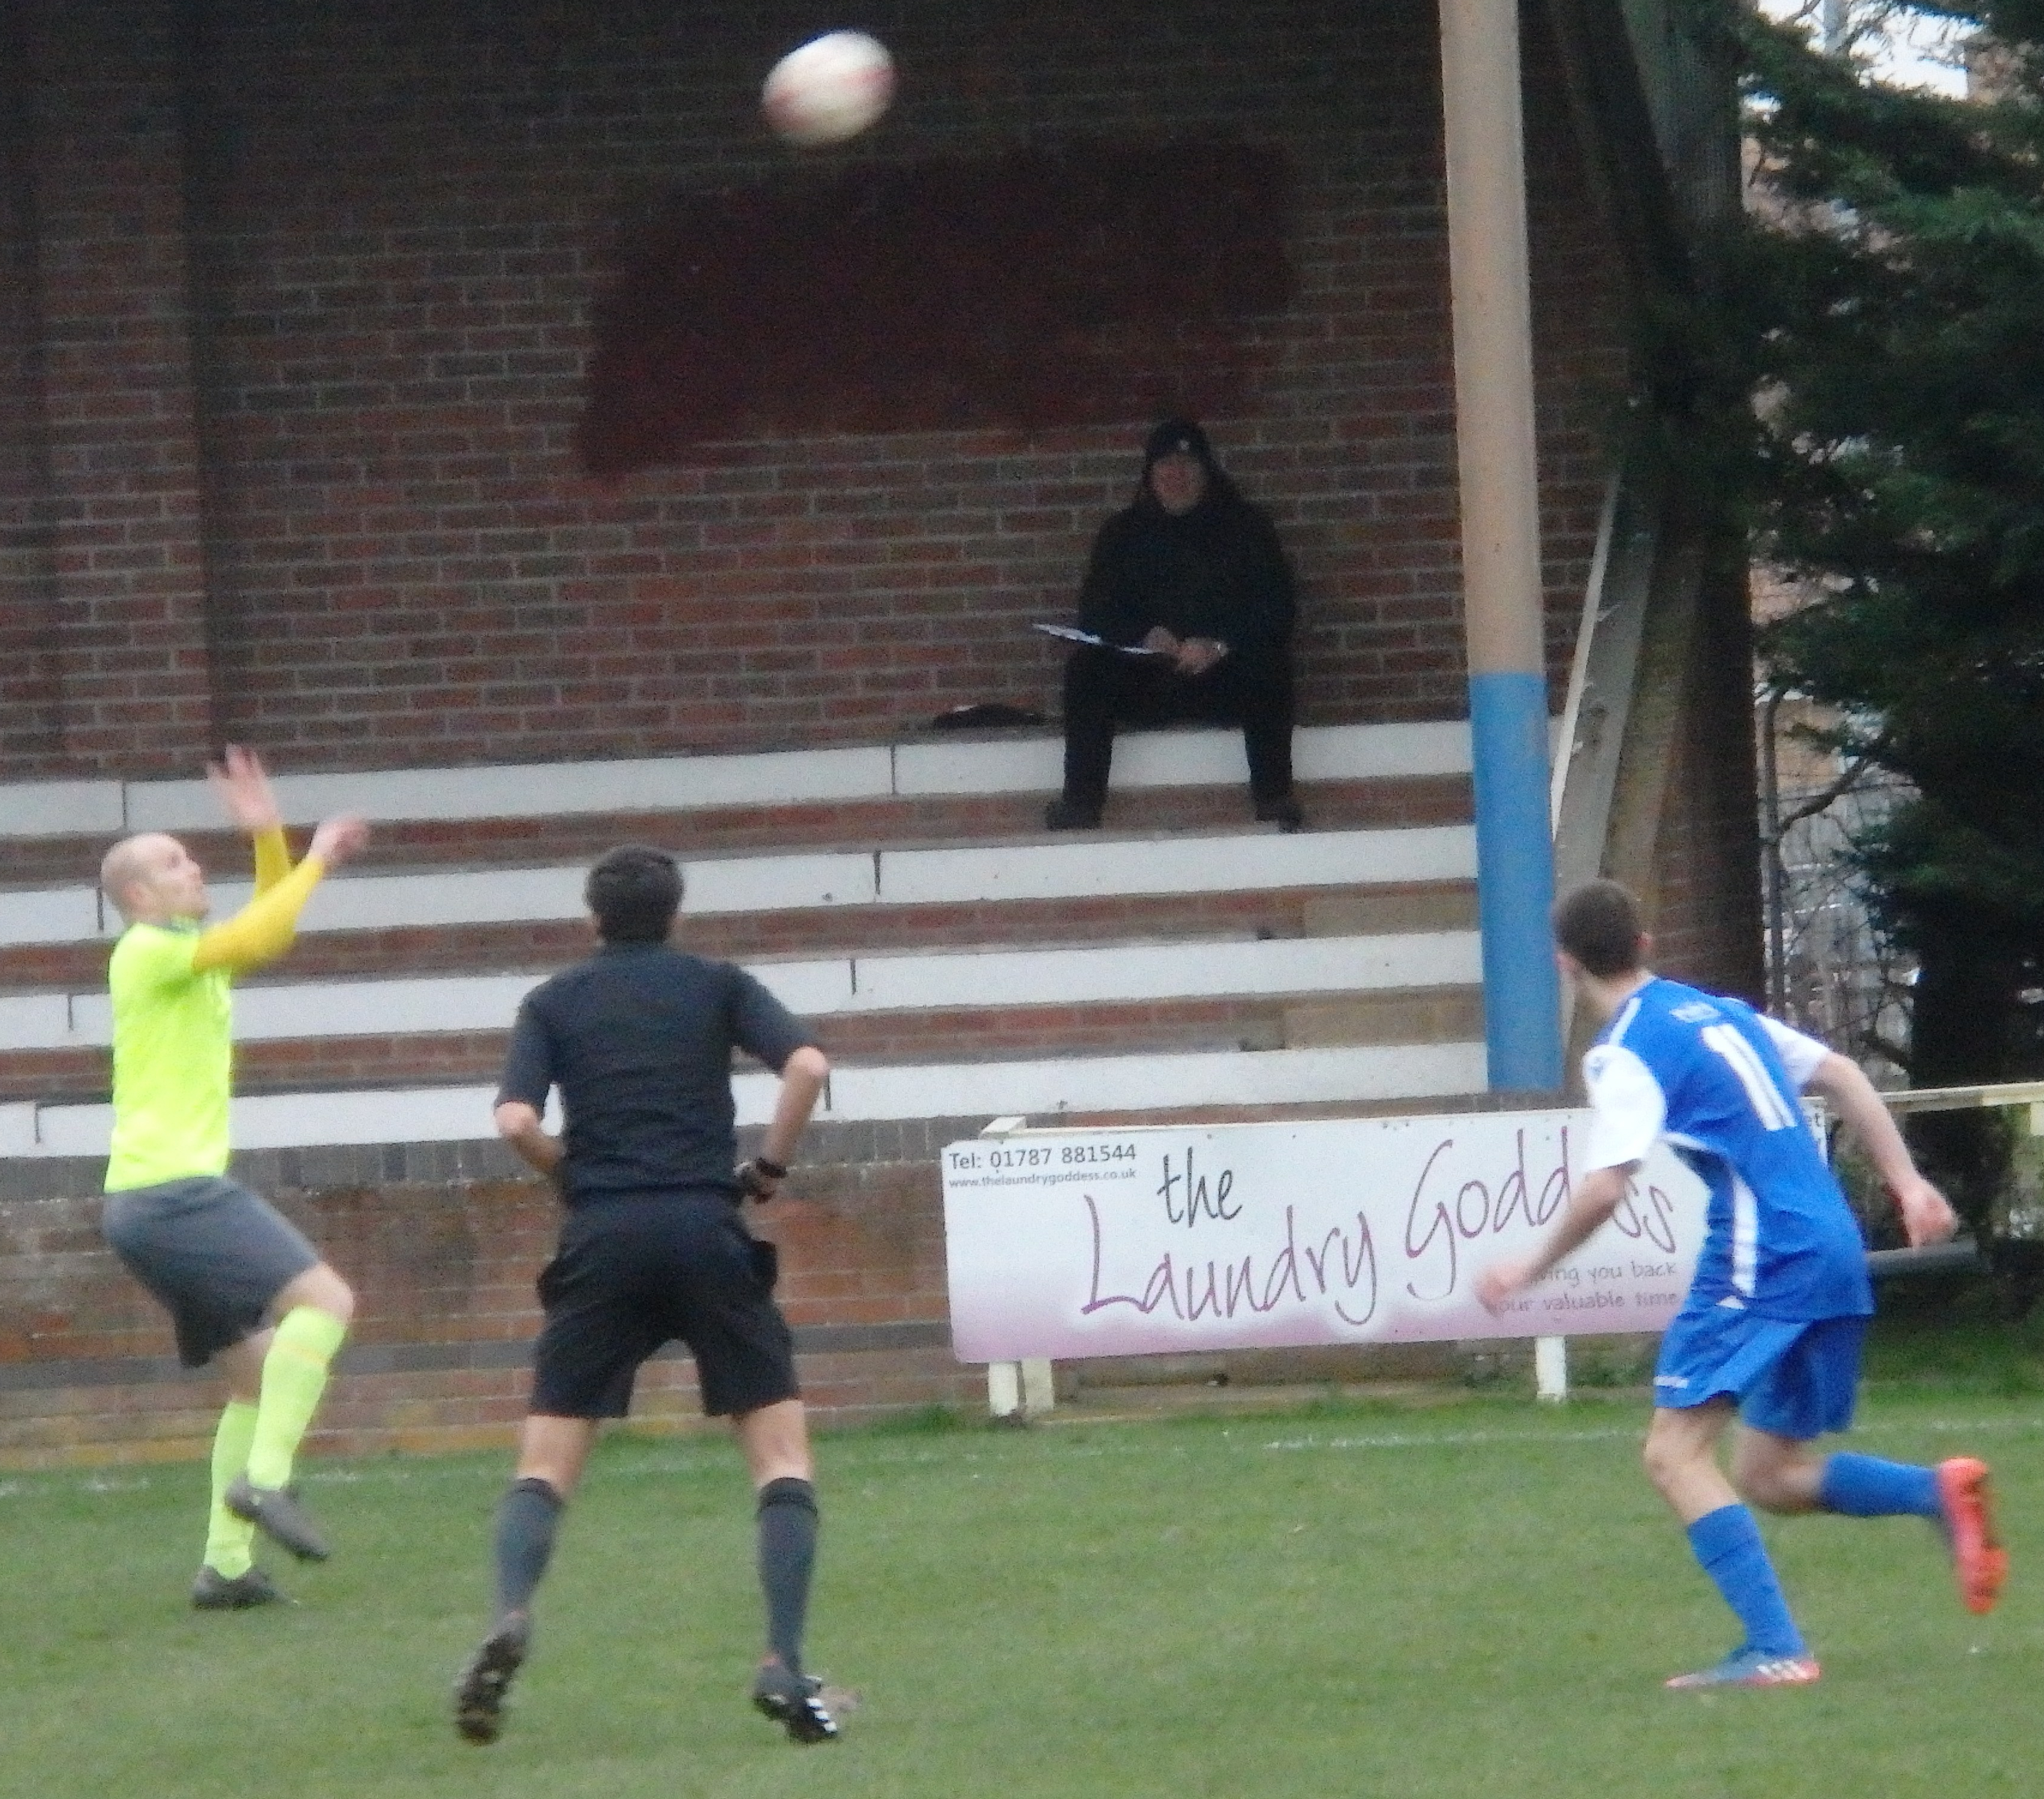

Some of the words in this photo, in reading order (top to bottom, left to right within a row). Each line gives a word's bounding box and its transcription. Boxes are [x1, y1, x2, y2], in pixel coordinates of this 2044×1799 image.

[1701, 1023, 1797, 1131] 11
[949, 1151, 982, 1169] Tel:
[990, 1147, 1053, 1168] 01787
[1061, 1143, 1136, 1164] 881544
[949, 1168, 1136, 1188] www.thelaundrygoddess.co.uk
[1157, 1146, 1243, 1228] the
[1081, 1194, 1377, 1325] Laundry
[1405, 1126, 1676, 1301] Goddss
[1588, 1266, 1622, 1284] you
[1630, 1260, 1677, 1278] back
[1543, 1290, 1625, 1310] valuable
[1634, 1291, 1677, 1307] time
